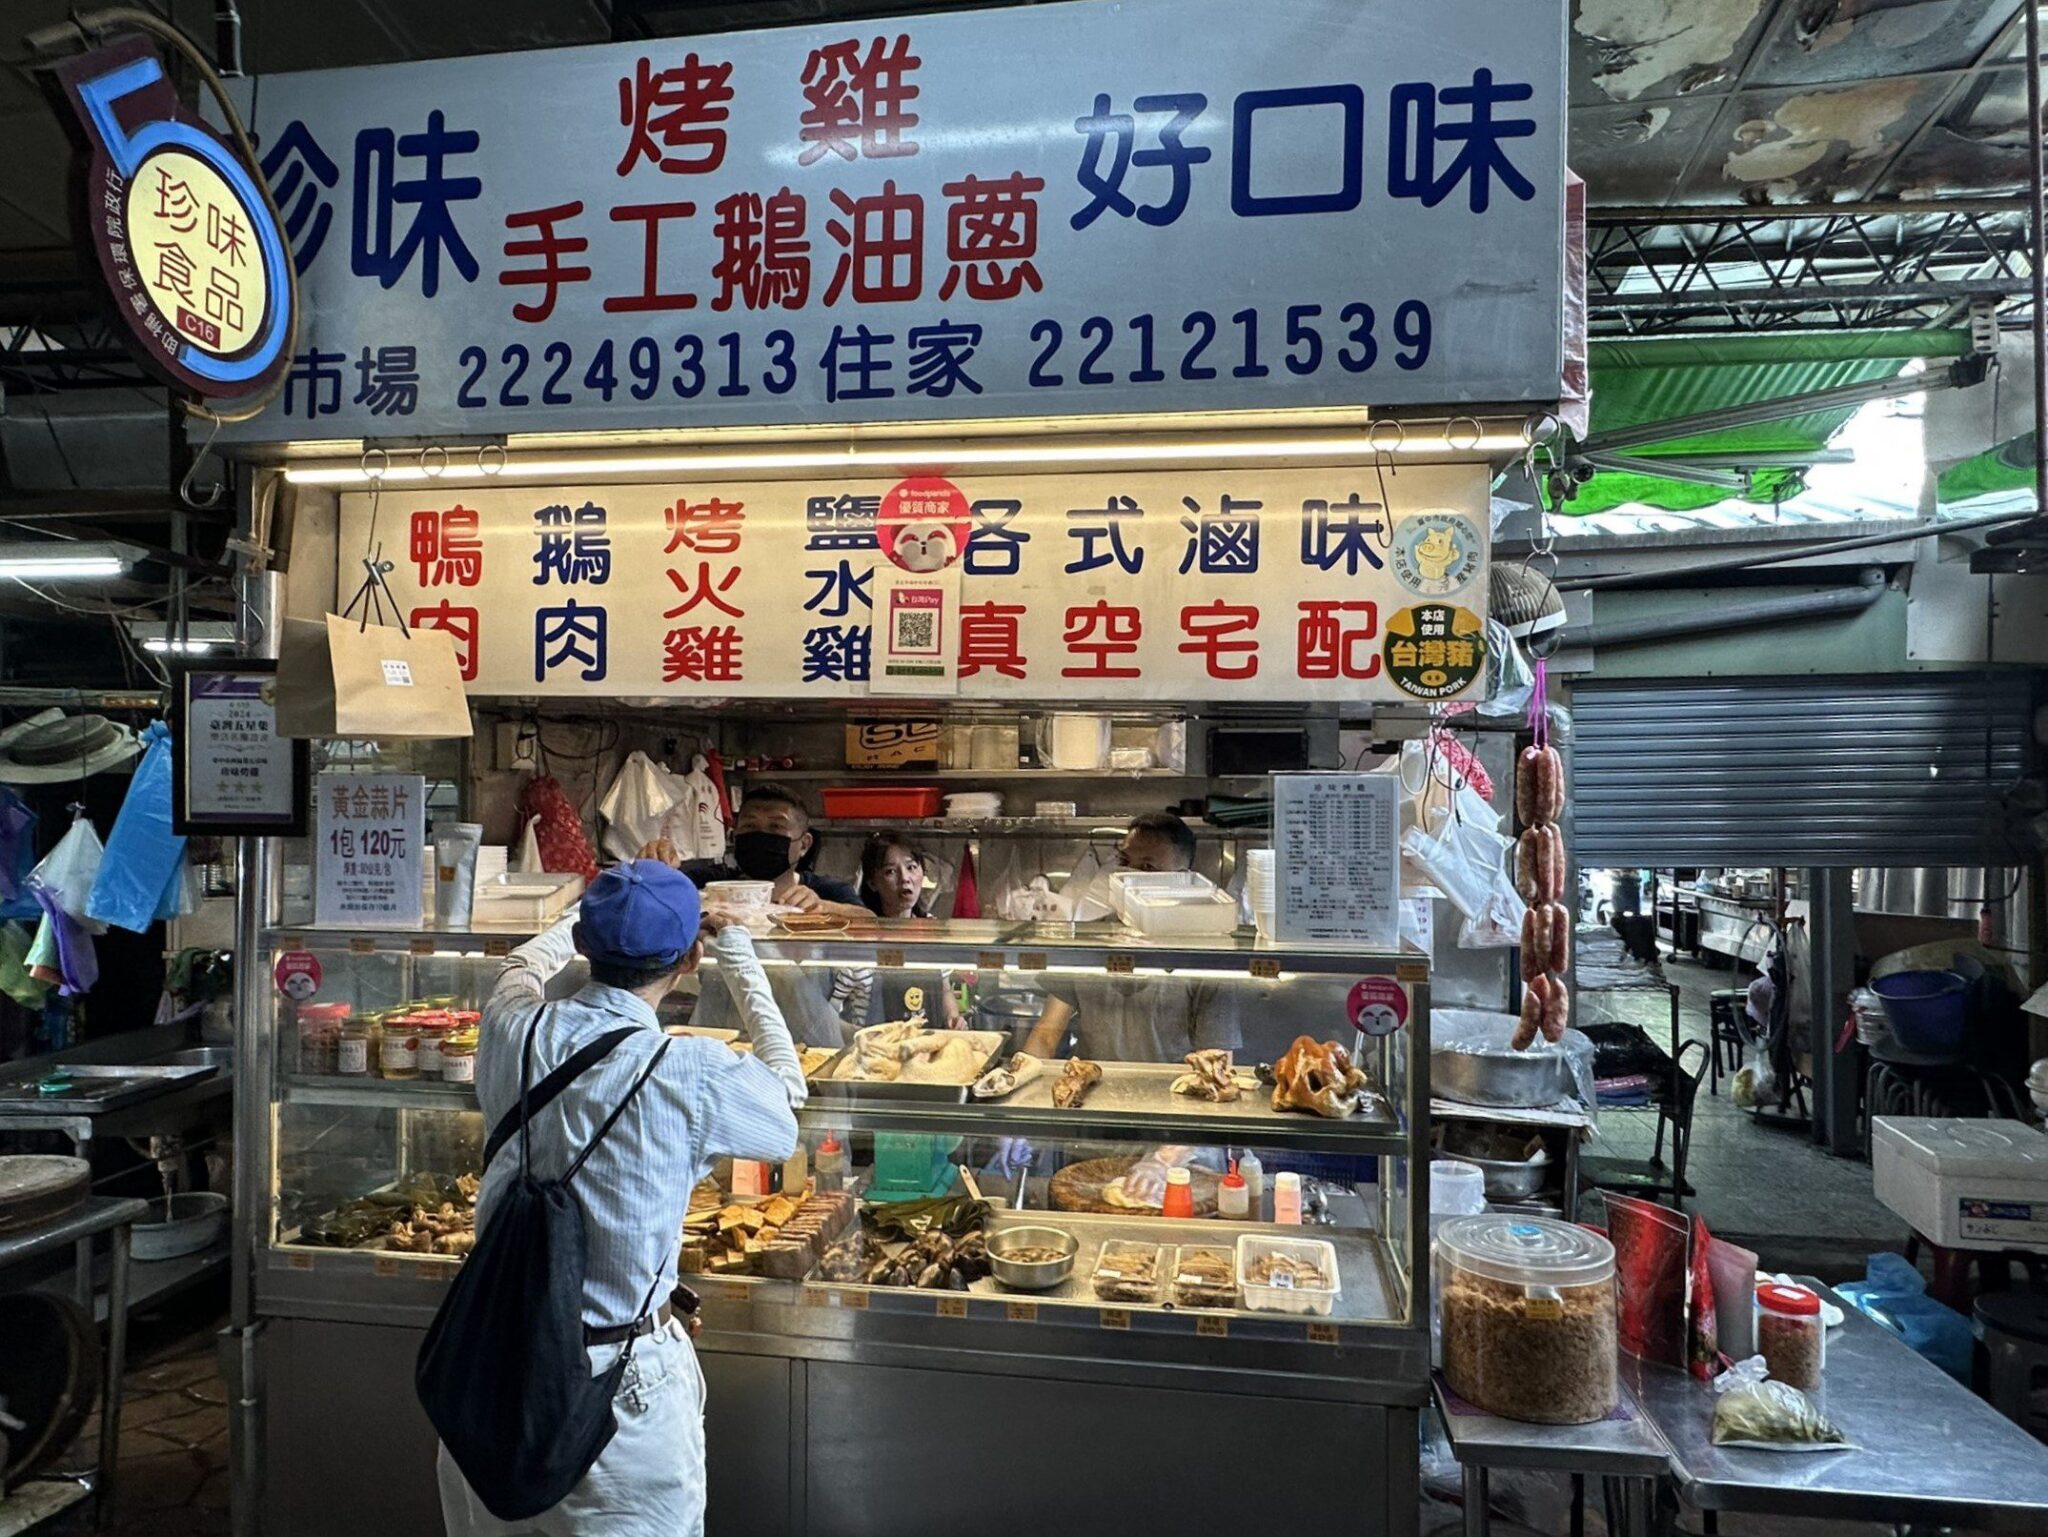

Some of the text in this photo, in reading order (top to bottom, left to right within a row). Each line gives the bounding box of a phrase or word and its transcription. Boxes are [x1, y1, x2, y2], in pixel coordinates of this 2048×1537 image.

[616, 33, 922, 177] 烤雞
[1069, 67, 1537, 231] 好口味
[152, 165, 248, 268] 珍味
[498, 170, 1046, 324] 手工鵝油蔥
[152, 240, 245, 333] 食品
[184, 312, 214, 342] C16
[283, 299, 1432, 421] 市場 22249313 住家 22121539
[963, 492, 1385, 576] 各式滷味
[532, 500, 612, 684] 鵝肉
[662, 496, 746, 683] 烤火雞
[1420, 609, 1446, 622] 本店
[1420, 623, 1446, 636] 使用
[957, 598, 1381, 680] 真空宅配
[1391, 639, 1475, 668] 台灣豬
[1399, 676, 1467, 698] TAIWAN PORK
[330, 827, 406, 859] 1包 120元
[332, 784, 409, 821] 黃金蒜片
